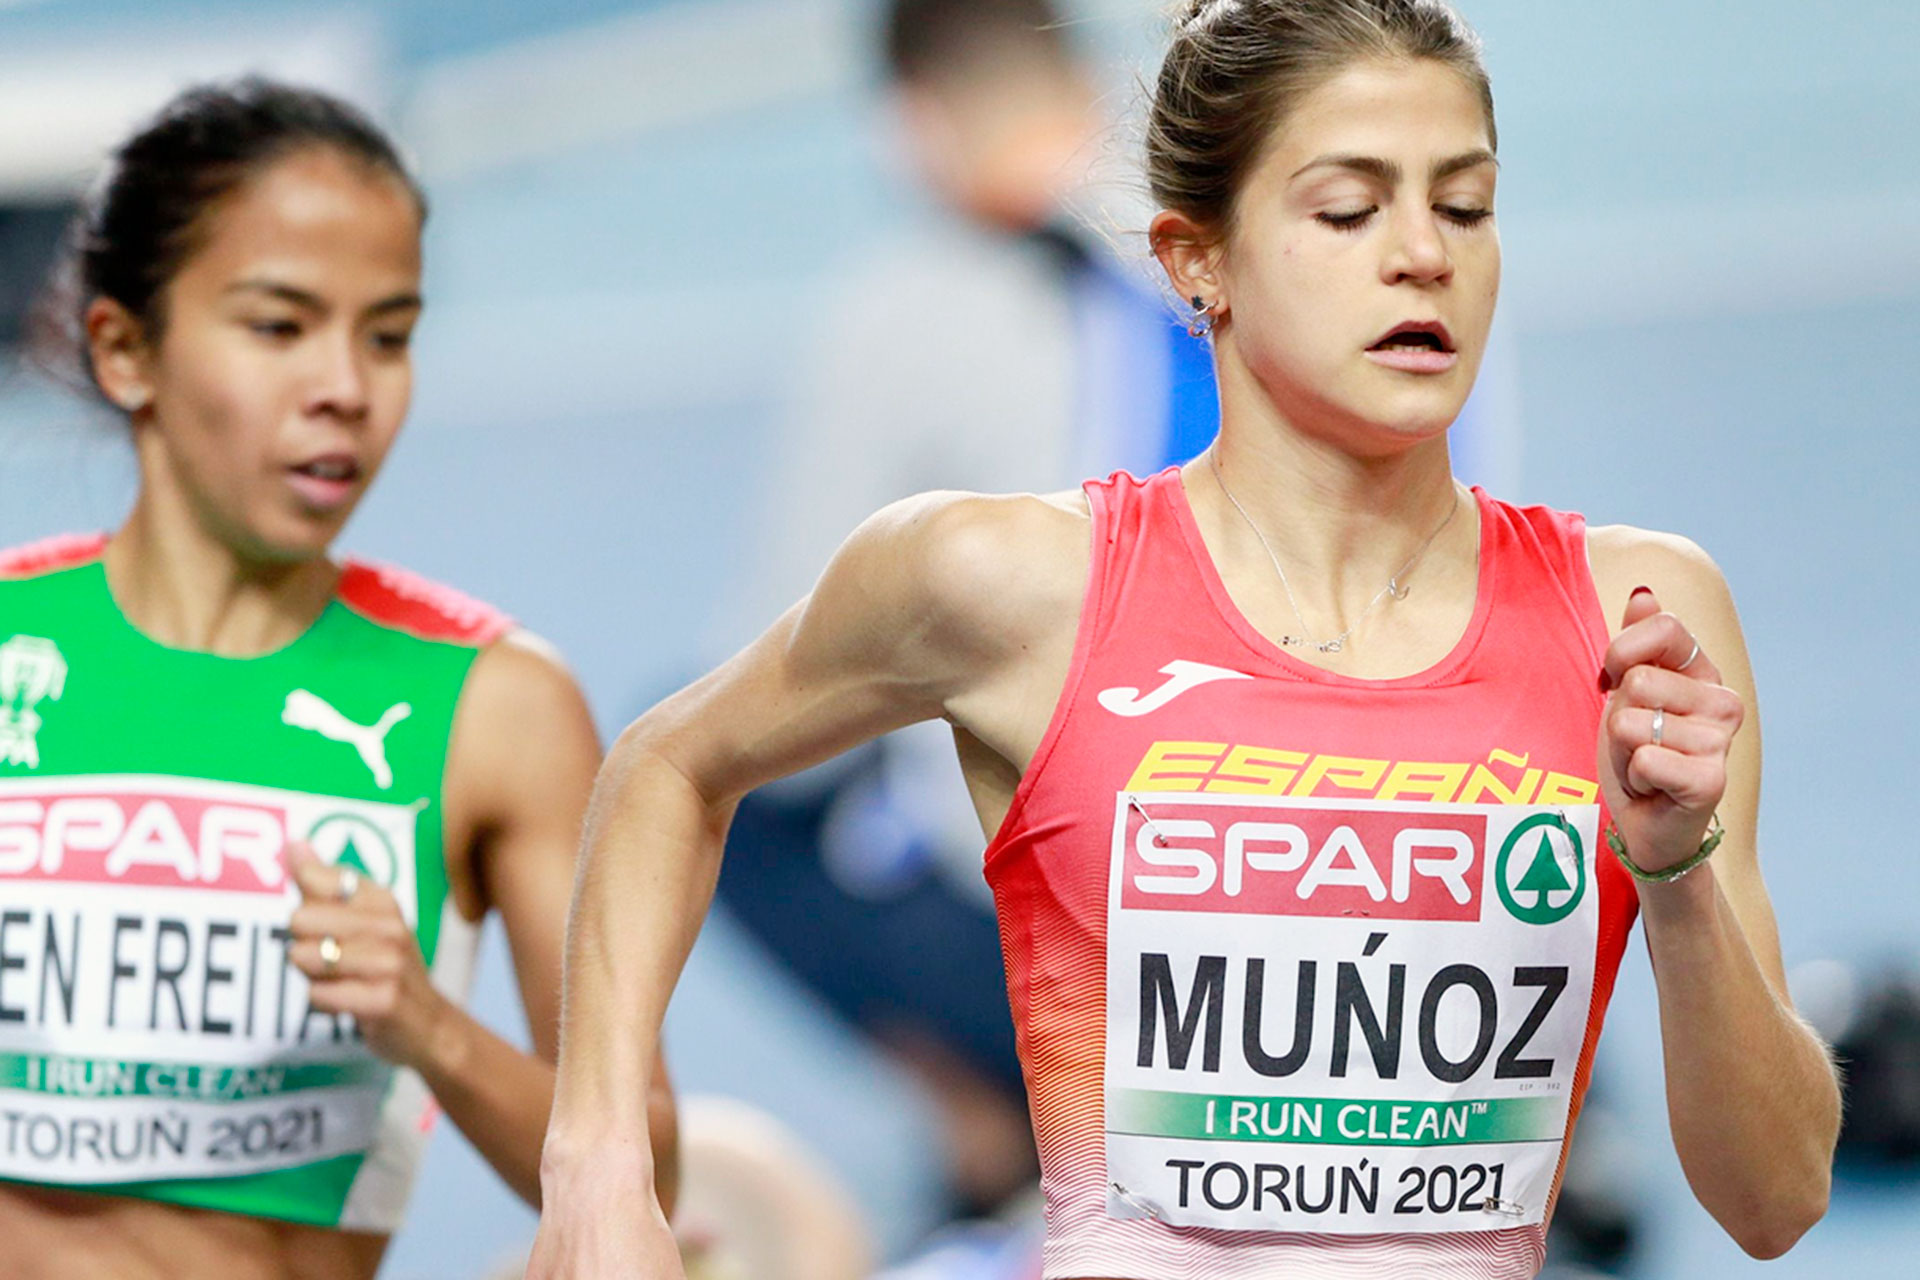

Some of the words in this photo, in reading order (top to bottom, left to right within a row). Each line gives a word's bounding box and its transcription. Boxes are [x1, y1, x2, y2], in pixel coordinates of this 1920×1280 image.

[1122, 741, 1600, 804] ESPAÑA
[1133, 819, 1474, 904] SPAR
[47, 1058, 137, 1096] RUN
[144, 1064, 287, 1098] CLEAN
[206, 1107, 324, 1157] 2021
[1205, 1101, 1214, 1133] I
[1230, 1101, 1322, 1138] RUN
[1166, 1157, 1379, 1214] TORUŃ
[1394, 1162, 1505, 1214] 2021
